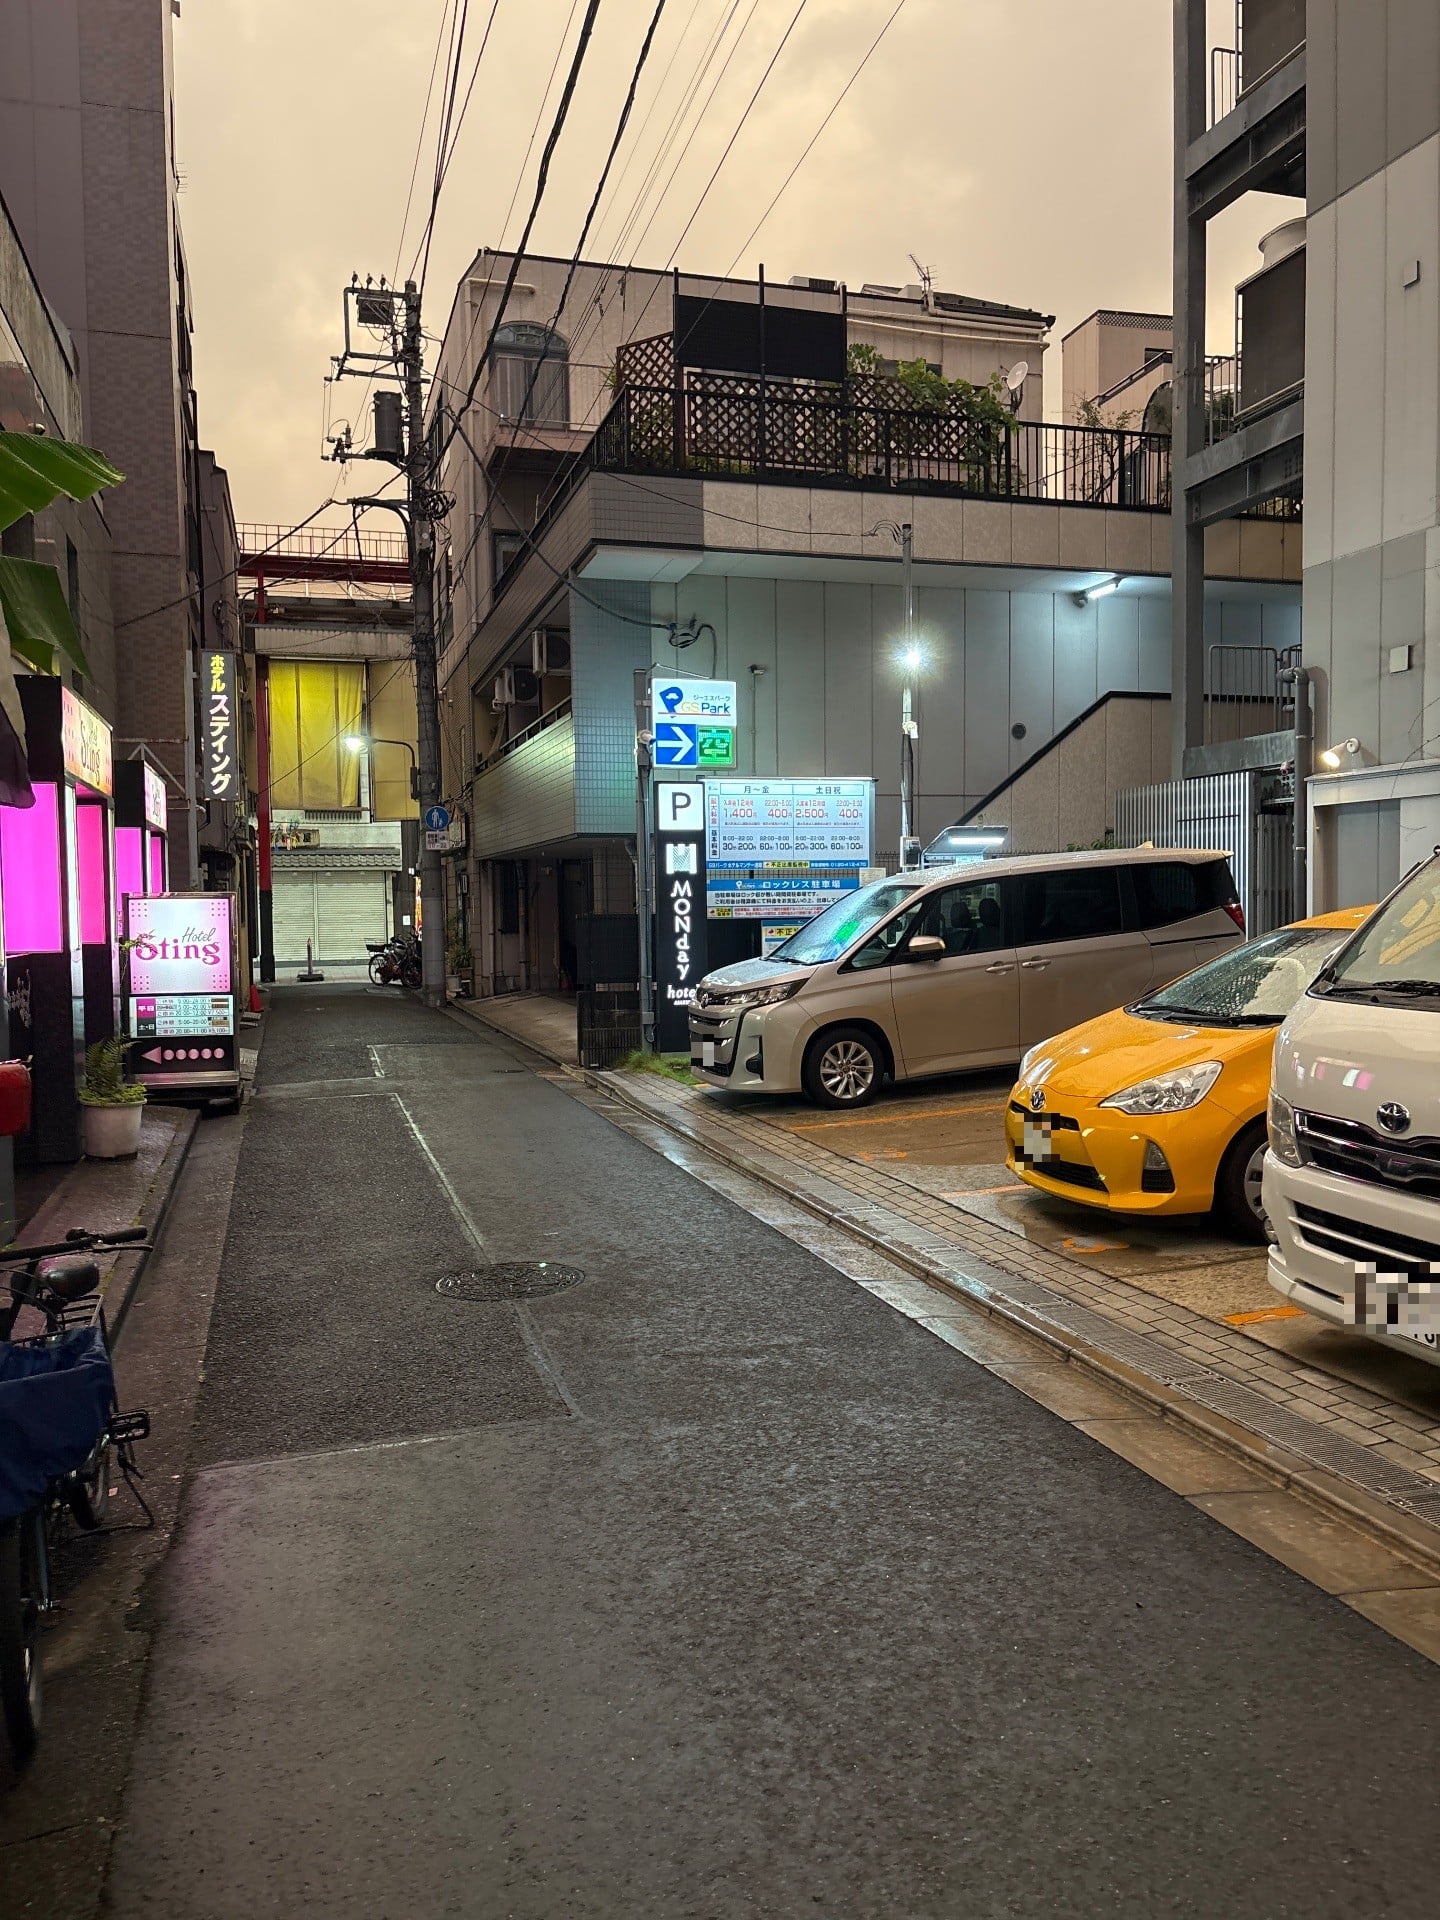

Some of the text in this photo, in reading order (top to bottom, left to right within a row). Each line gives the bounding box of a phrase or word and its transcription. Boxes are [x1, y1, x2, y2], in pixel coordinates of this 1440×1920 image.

[693, 694, 731, 702] ジーエスパーク
[701, 702, 731, 714] Park
[209, 654, 232, 795] ホテル スティング
[815, 785, 841, 795] 土日祝
[671, 791, 692, 821] P
[762, 879, 841, 890] ロックレス駐車場
[181, 926, 216, 943] Hotel
[776, 927, 800, 936] 不正
[135, 931, 221, 966] Sting
[666, 983, 701, 1000] hote
